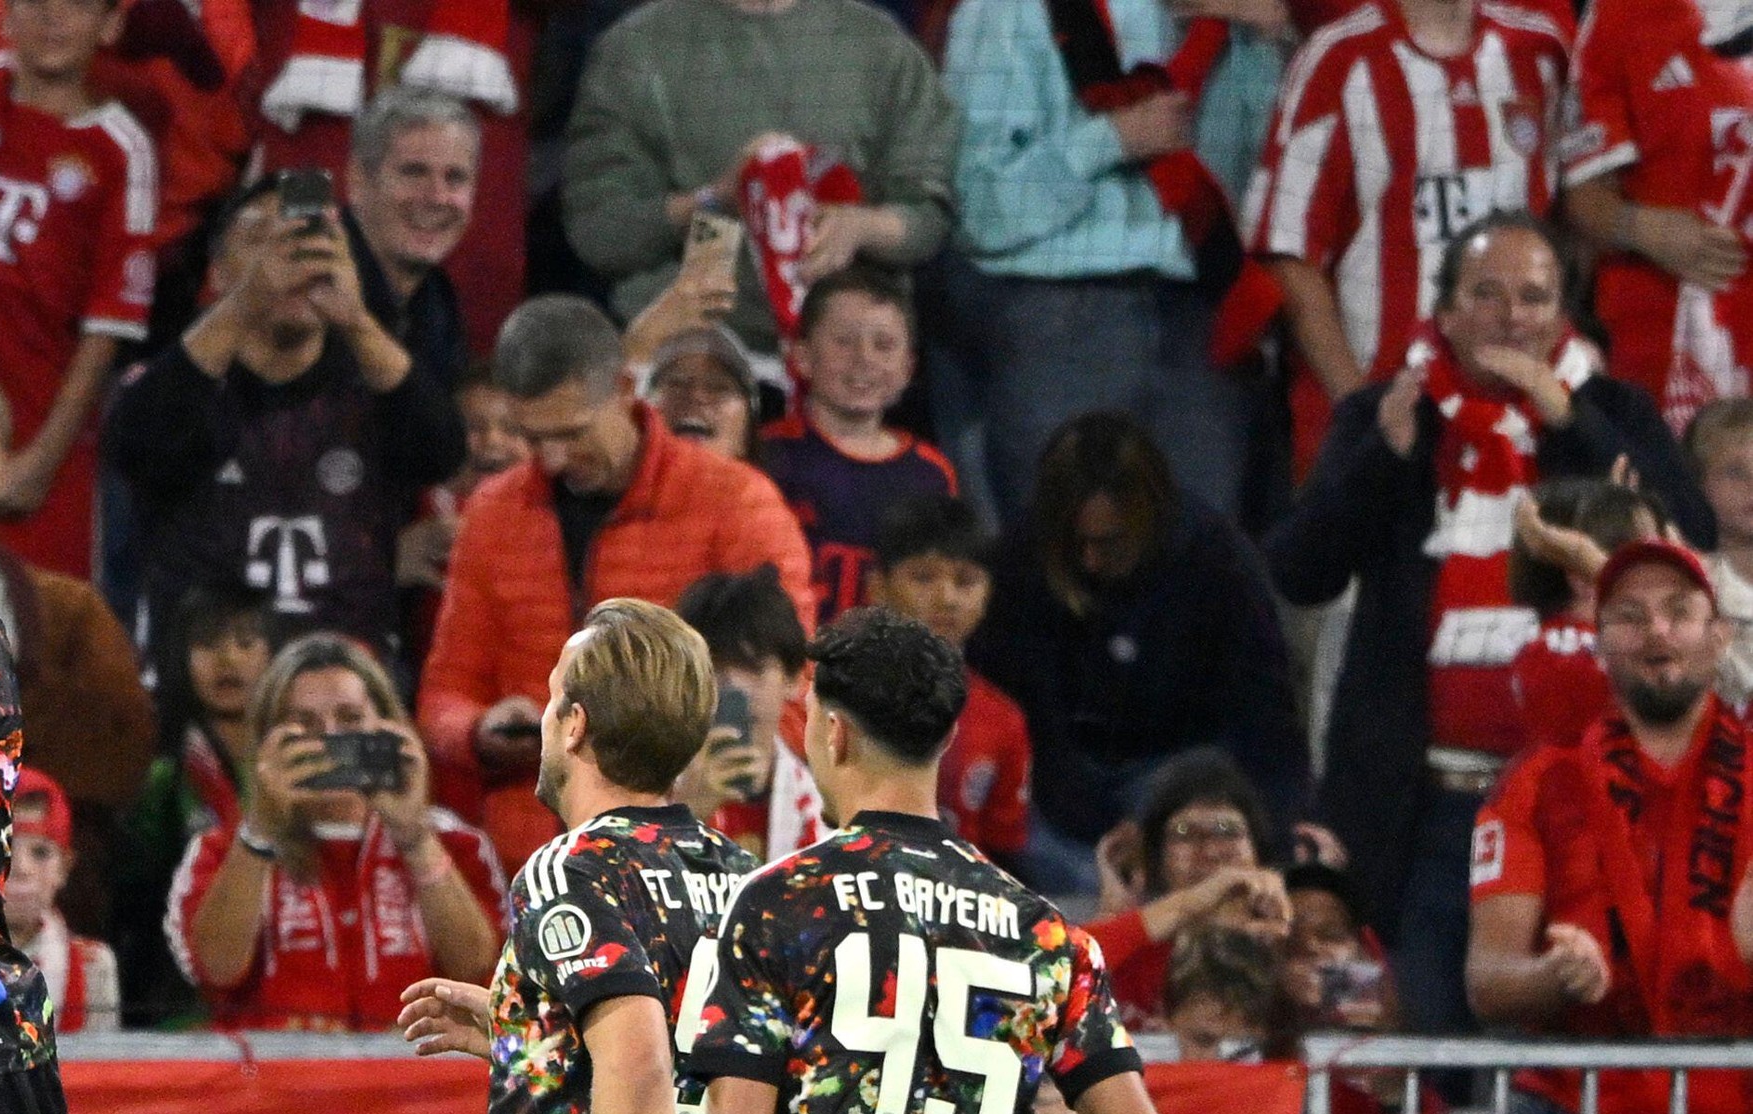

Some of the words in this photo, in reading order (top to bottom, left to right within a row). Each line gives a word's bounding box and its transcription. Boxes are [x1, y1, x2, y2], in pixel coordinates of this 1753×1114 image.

[245, 515, 329, 614] T
[639, 868, 683, 910] FC
[832, 871, 885, 912] FC
[894, 872, 1021, 940] BAYERN
